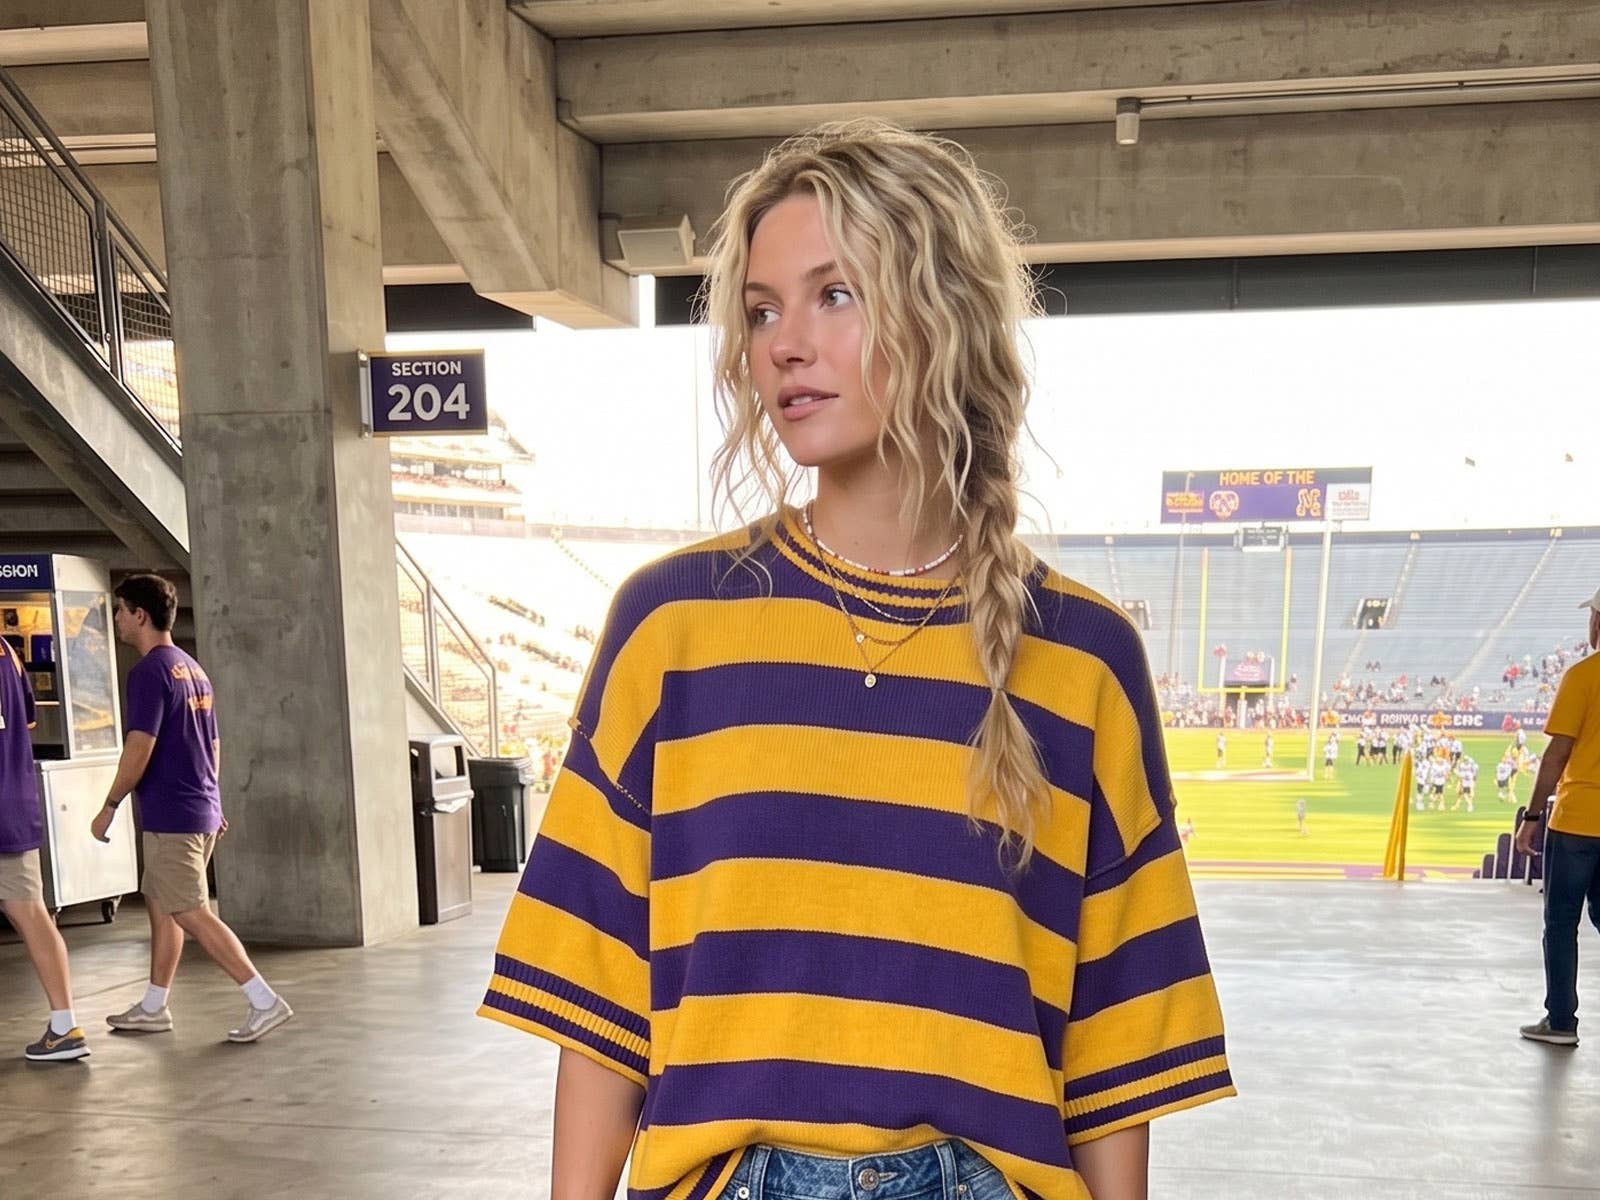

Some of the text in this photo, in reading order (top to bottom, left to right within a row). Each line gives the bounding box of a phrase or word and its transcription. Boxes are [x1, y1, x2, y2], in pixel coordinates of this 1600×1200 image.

[391, 361, 462, 376] SECTION
[388, 383, 470, 421] 204
[1219, 470, 1315, 486] HOME OF THE
[0, 564, 38, 578] SION
